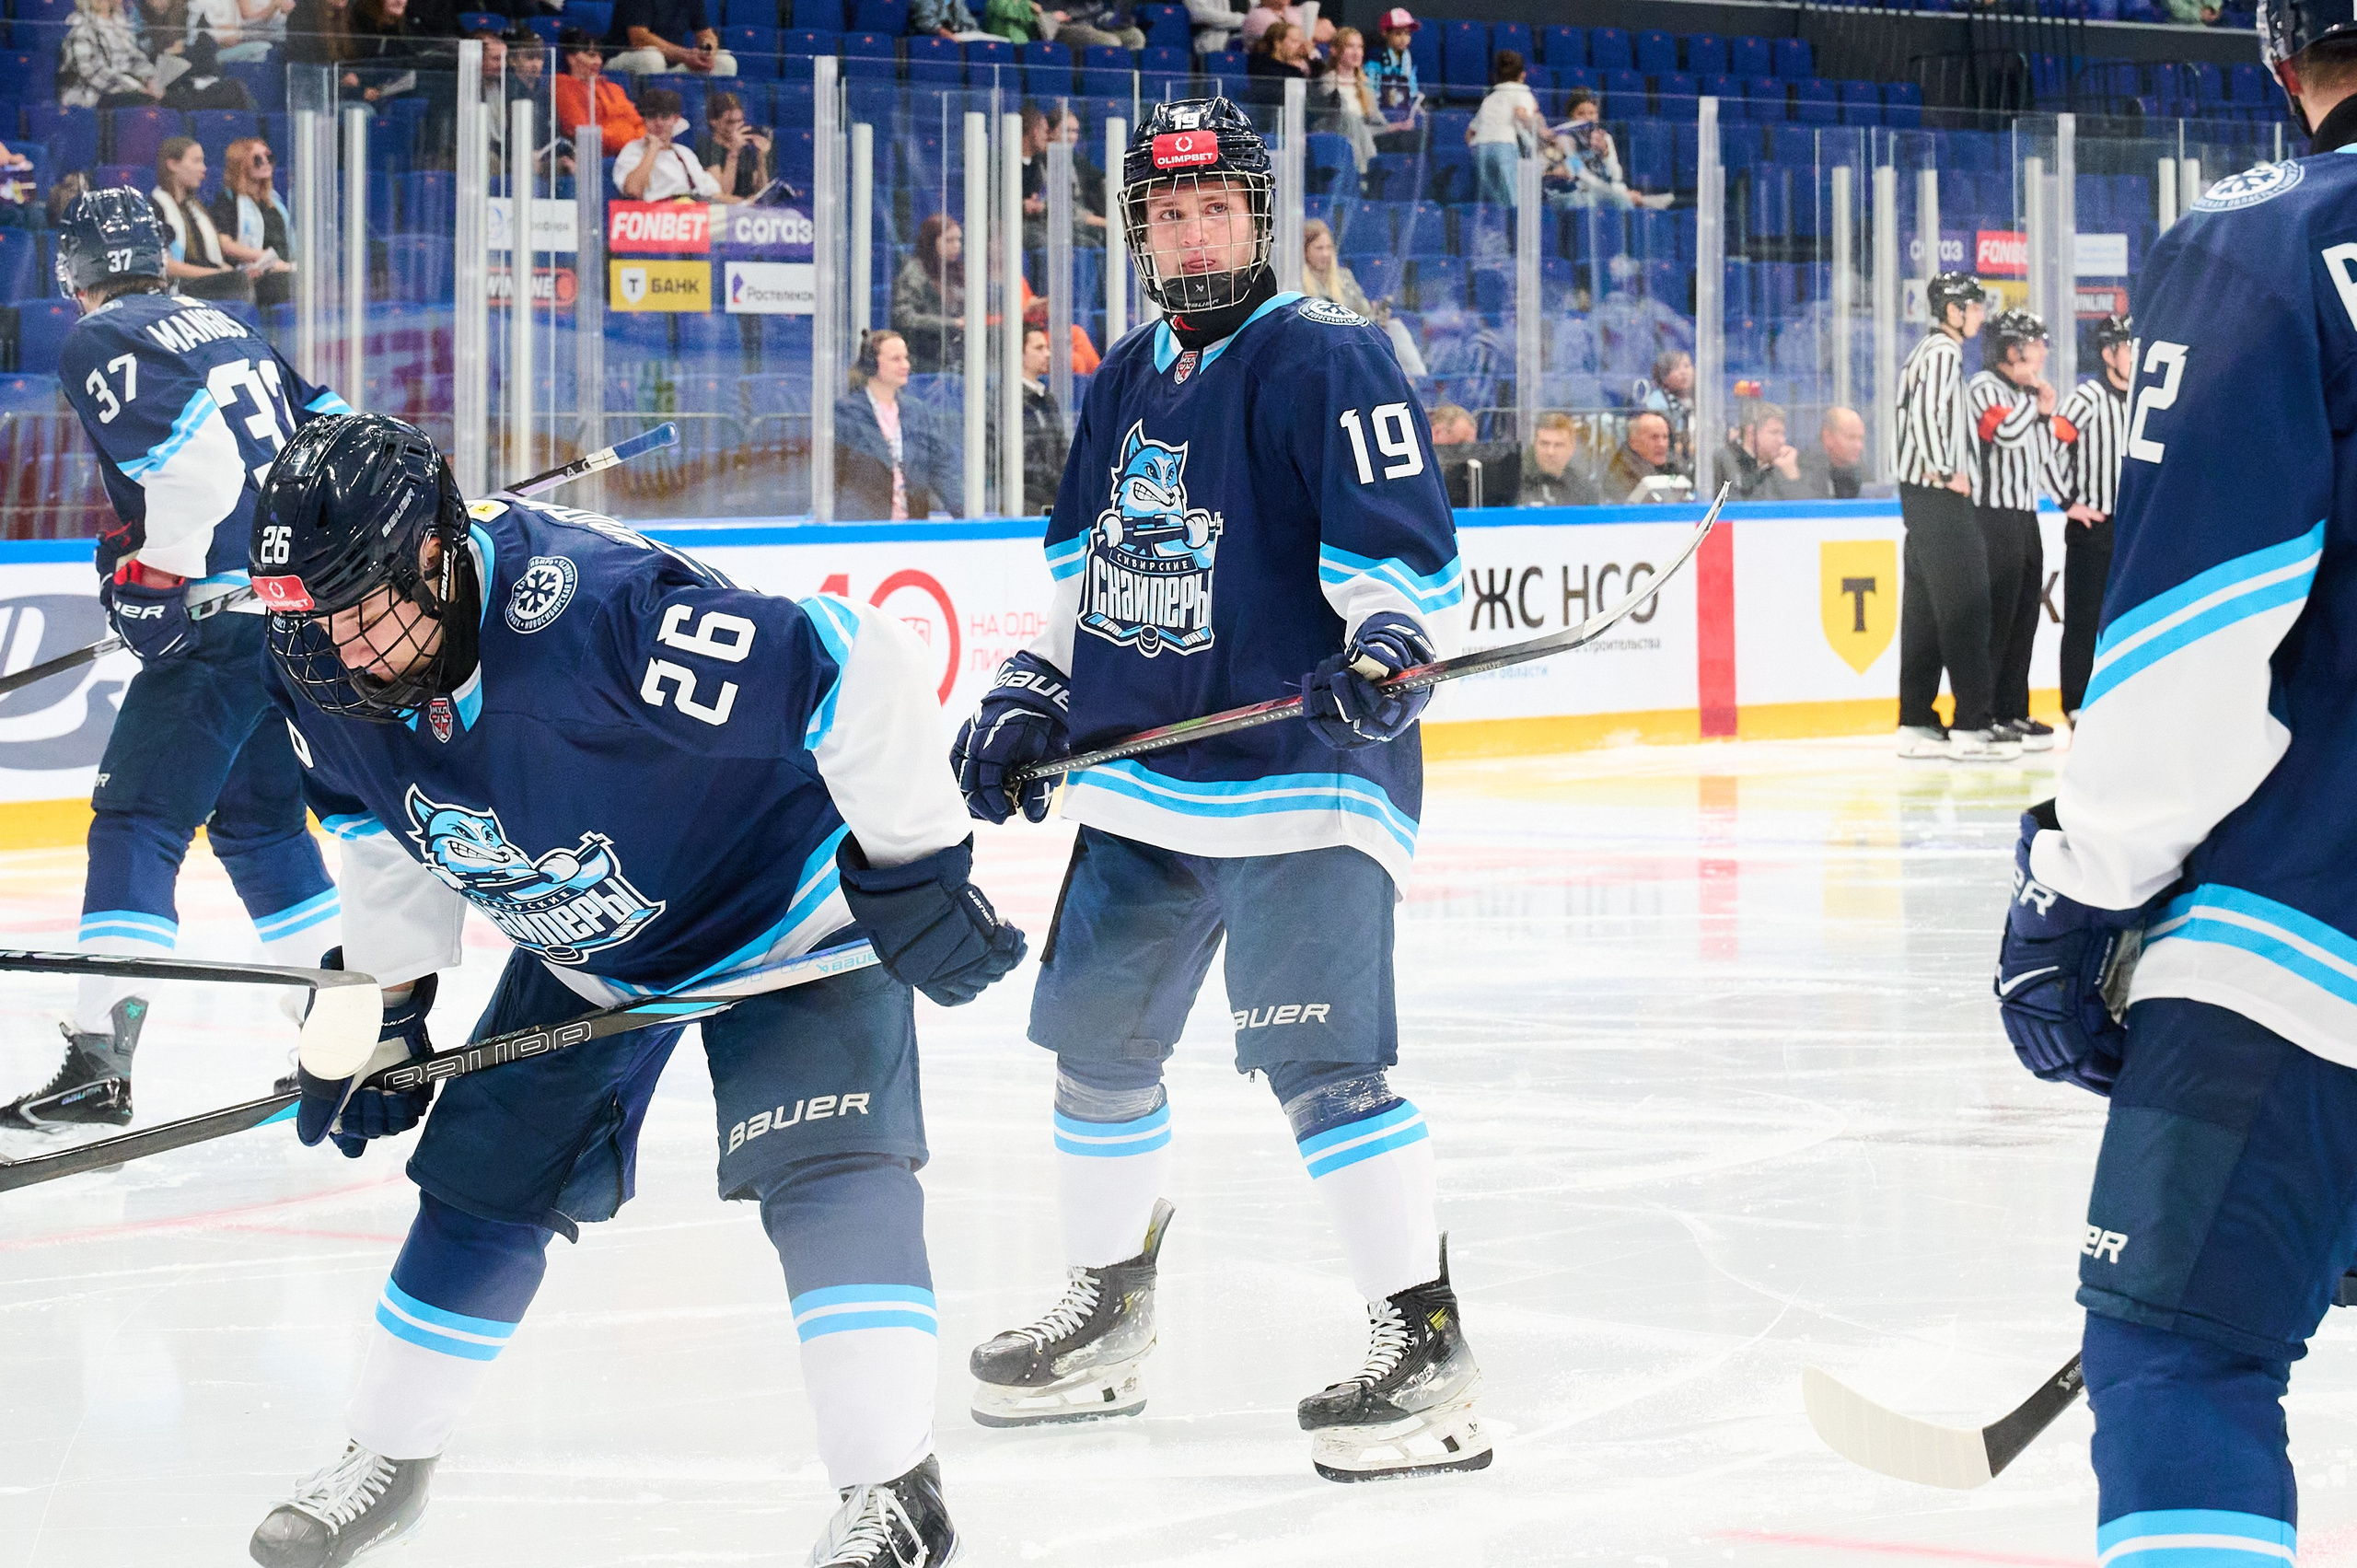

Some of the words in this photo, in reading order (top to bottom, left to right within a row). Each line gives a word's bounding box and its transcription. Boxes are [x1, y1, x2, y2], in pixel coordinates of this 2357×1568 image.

[1172, 112, 1201, 130] 19
[1157, 153, 1213, 165] OLIMPBET
[610, 212, 707, 241] FONBET
[107, 248, 133, 273] 37
[651, 279, 700, 294] БАНК
[86, 353, 137, 424] 37
[2121, 337, 2189, 463] 2
[1340, 401, 1425, 486] 19
[261, 526, 292, 564] 26
[440, 550, 450, 601] BAUER
[1117, 553, 1189, 572] СИБИРСКИЕ
[1469, 565, 1545, 632] ЖС
[1562, 562, 1661, 627] НСО
[970, 614, 999, 637] НА
[640, 603, 757, 726] 26
[994, 670, 1071, 714] BAUE
[470, 890, 570, 912] СИБИРСКИЕ
[831, 952, 879, 972] BAUE
[1235, 1004, 1331, 1030] AUER
[726, 1092, 871, 1156] BAUER
